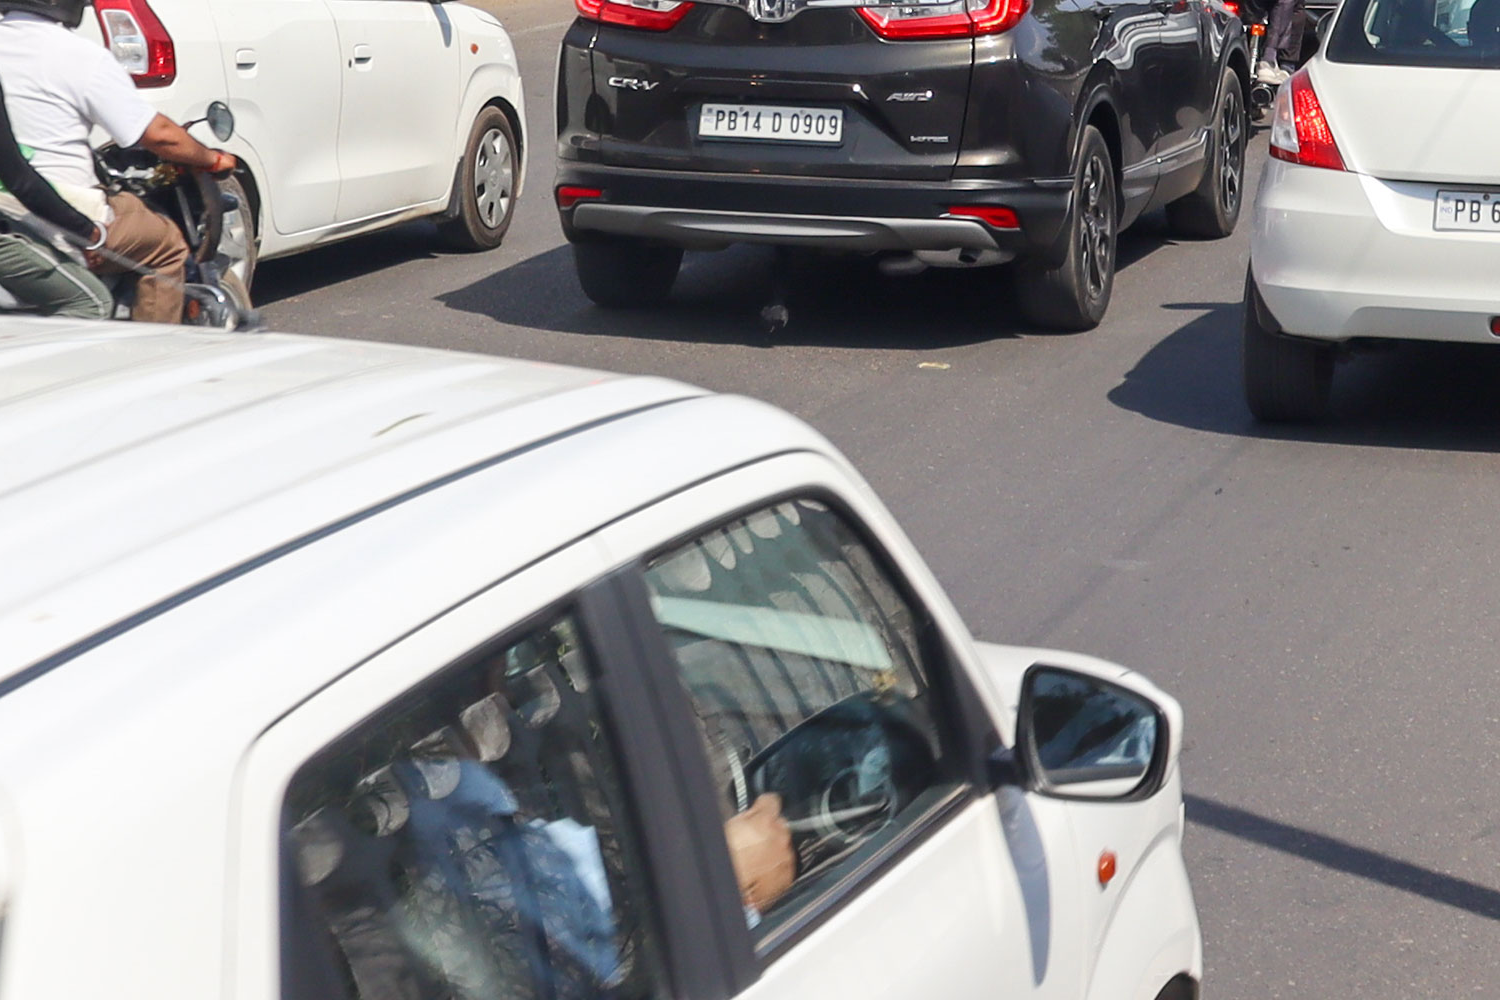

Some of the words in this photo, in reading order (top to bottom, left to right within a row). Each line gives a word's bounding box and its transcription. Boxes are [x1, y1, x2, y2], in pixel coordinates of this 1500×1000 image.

[608, 77, 660, 91] CR-V
[714, 109, 762, 132] PB14
[772, 112, 783, 134] D
[790, 113, 839, 136] 0909
[1454, 199, 1481, 223] PB
